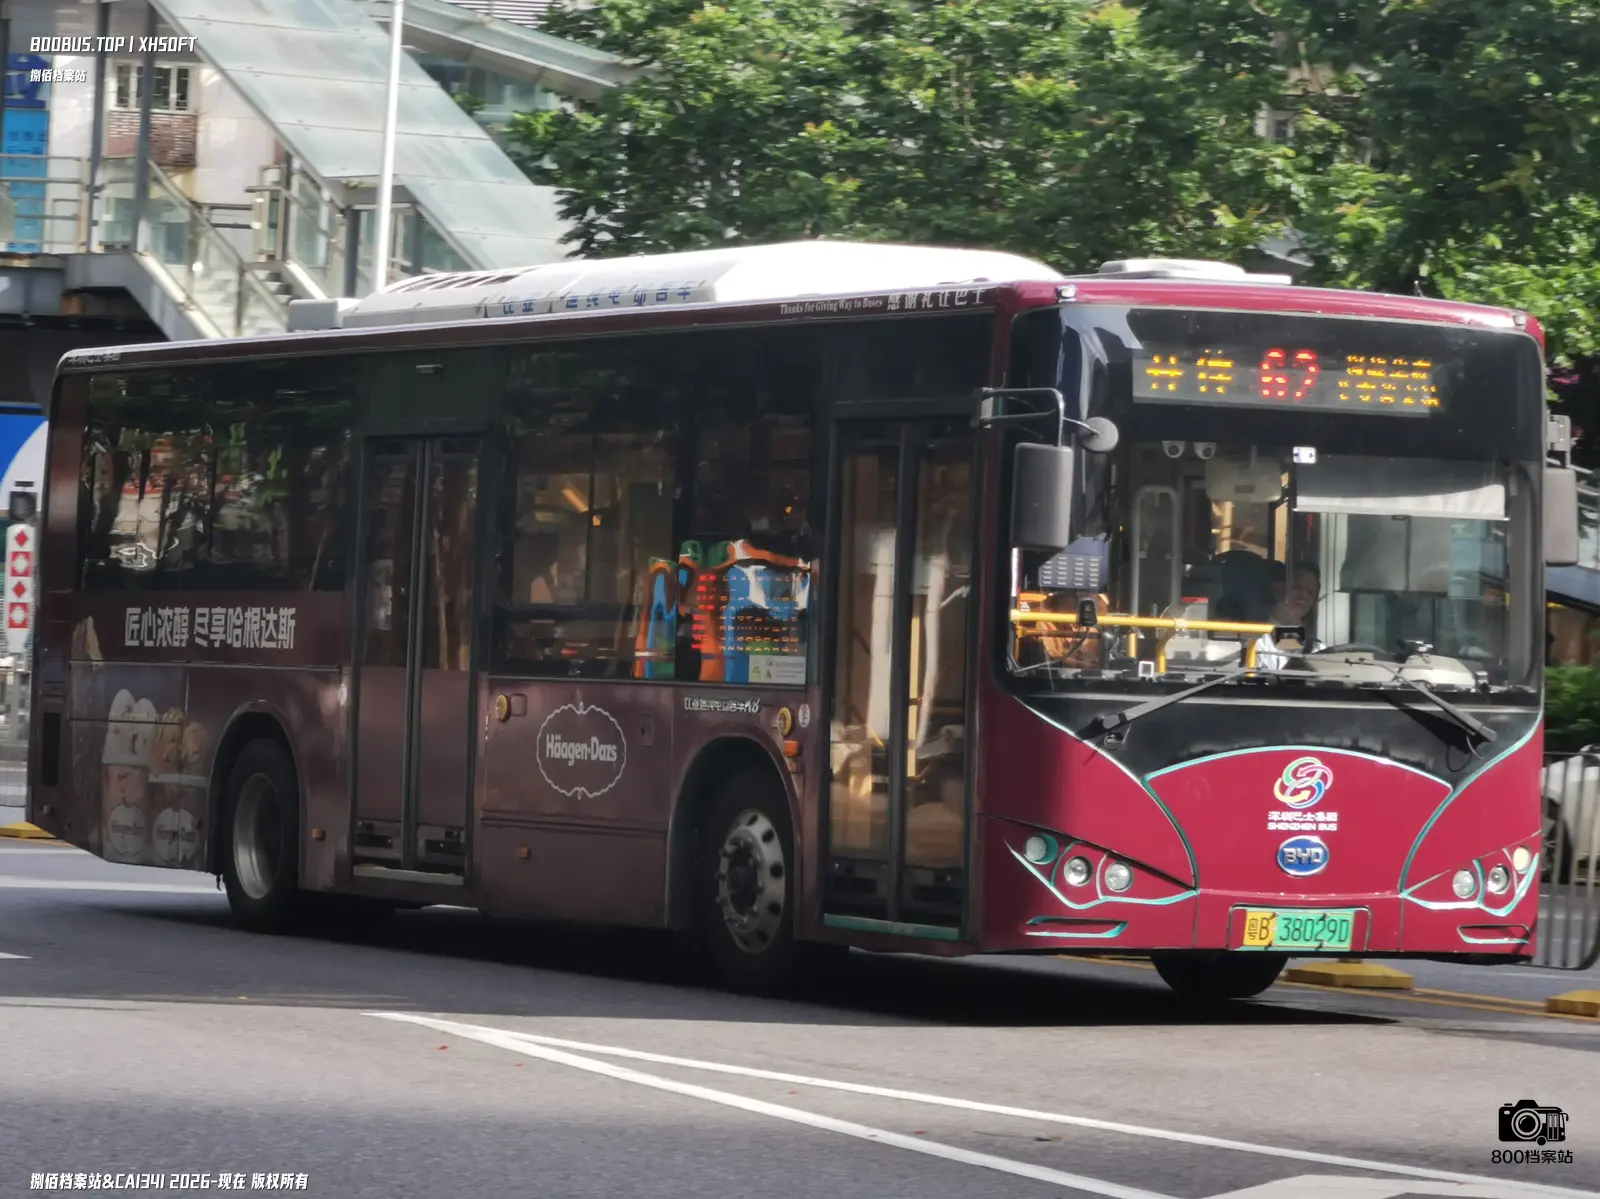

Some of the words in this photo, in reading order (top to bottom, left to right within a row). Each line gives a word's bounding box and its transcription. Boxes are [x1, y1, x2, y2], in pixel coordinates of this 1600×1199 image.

[780, 303, 804, 315] Thanks
[804, 302, 815, 313] for
[815, 300, 838, 312] Giving
[838, 298, 853, 312] Way
[854, 299, 862, 309] to
[863, 297, 883, 309] Buses
[886, 288, 986, 310] 感谢礼让巴士
[125, 606, 190, 648] 匠心浓醇
[193, 606, 297, 649] 尽享哈根达斯
[1283, 847, 1324, 864] BYD
